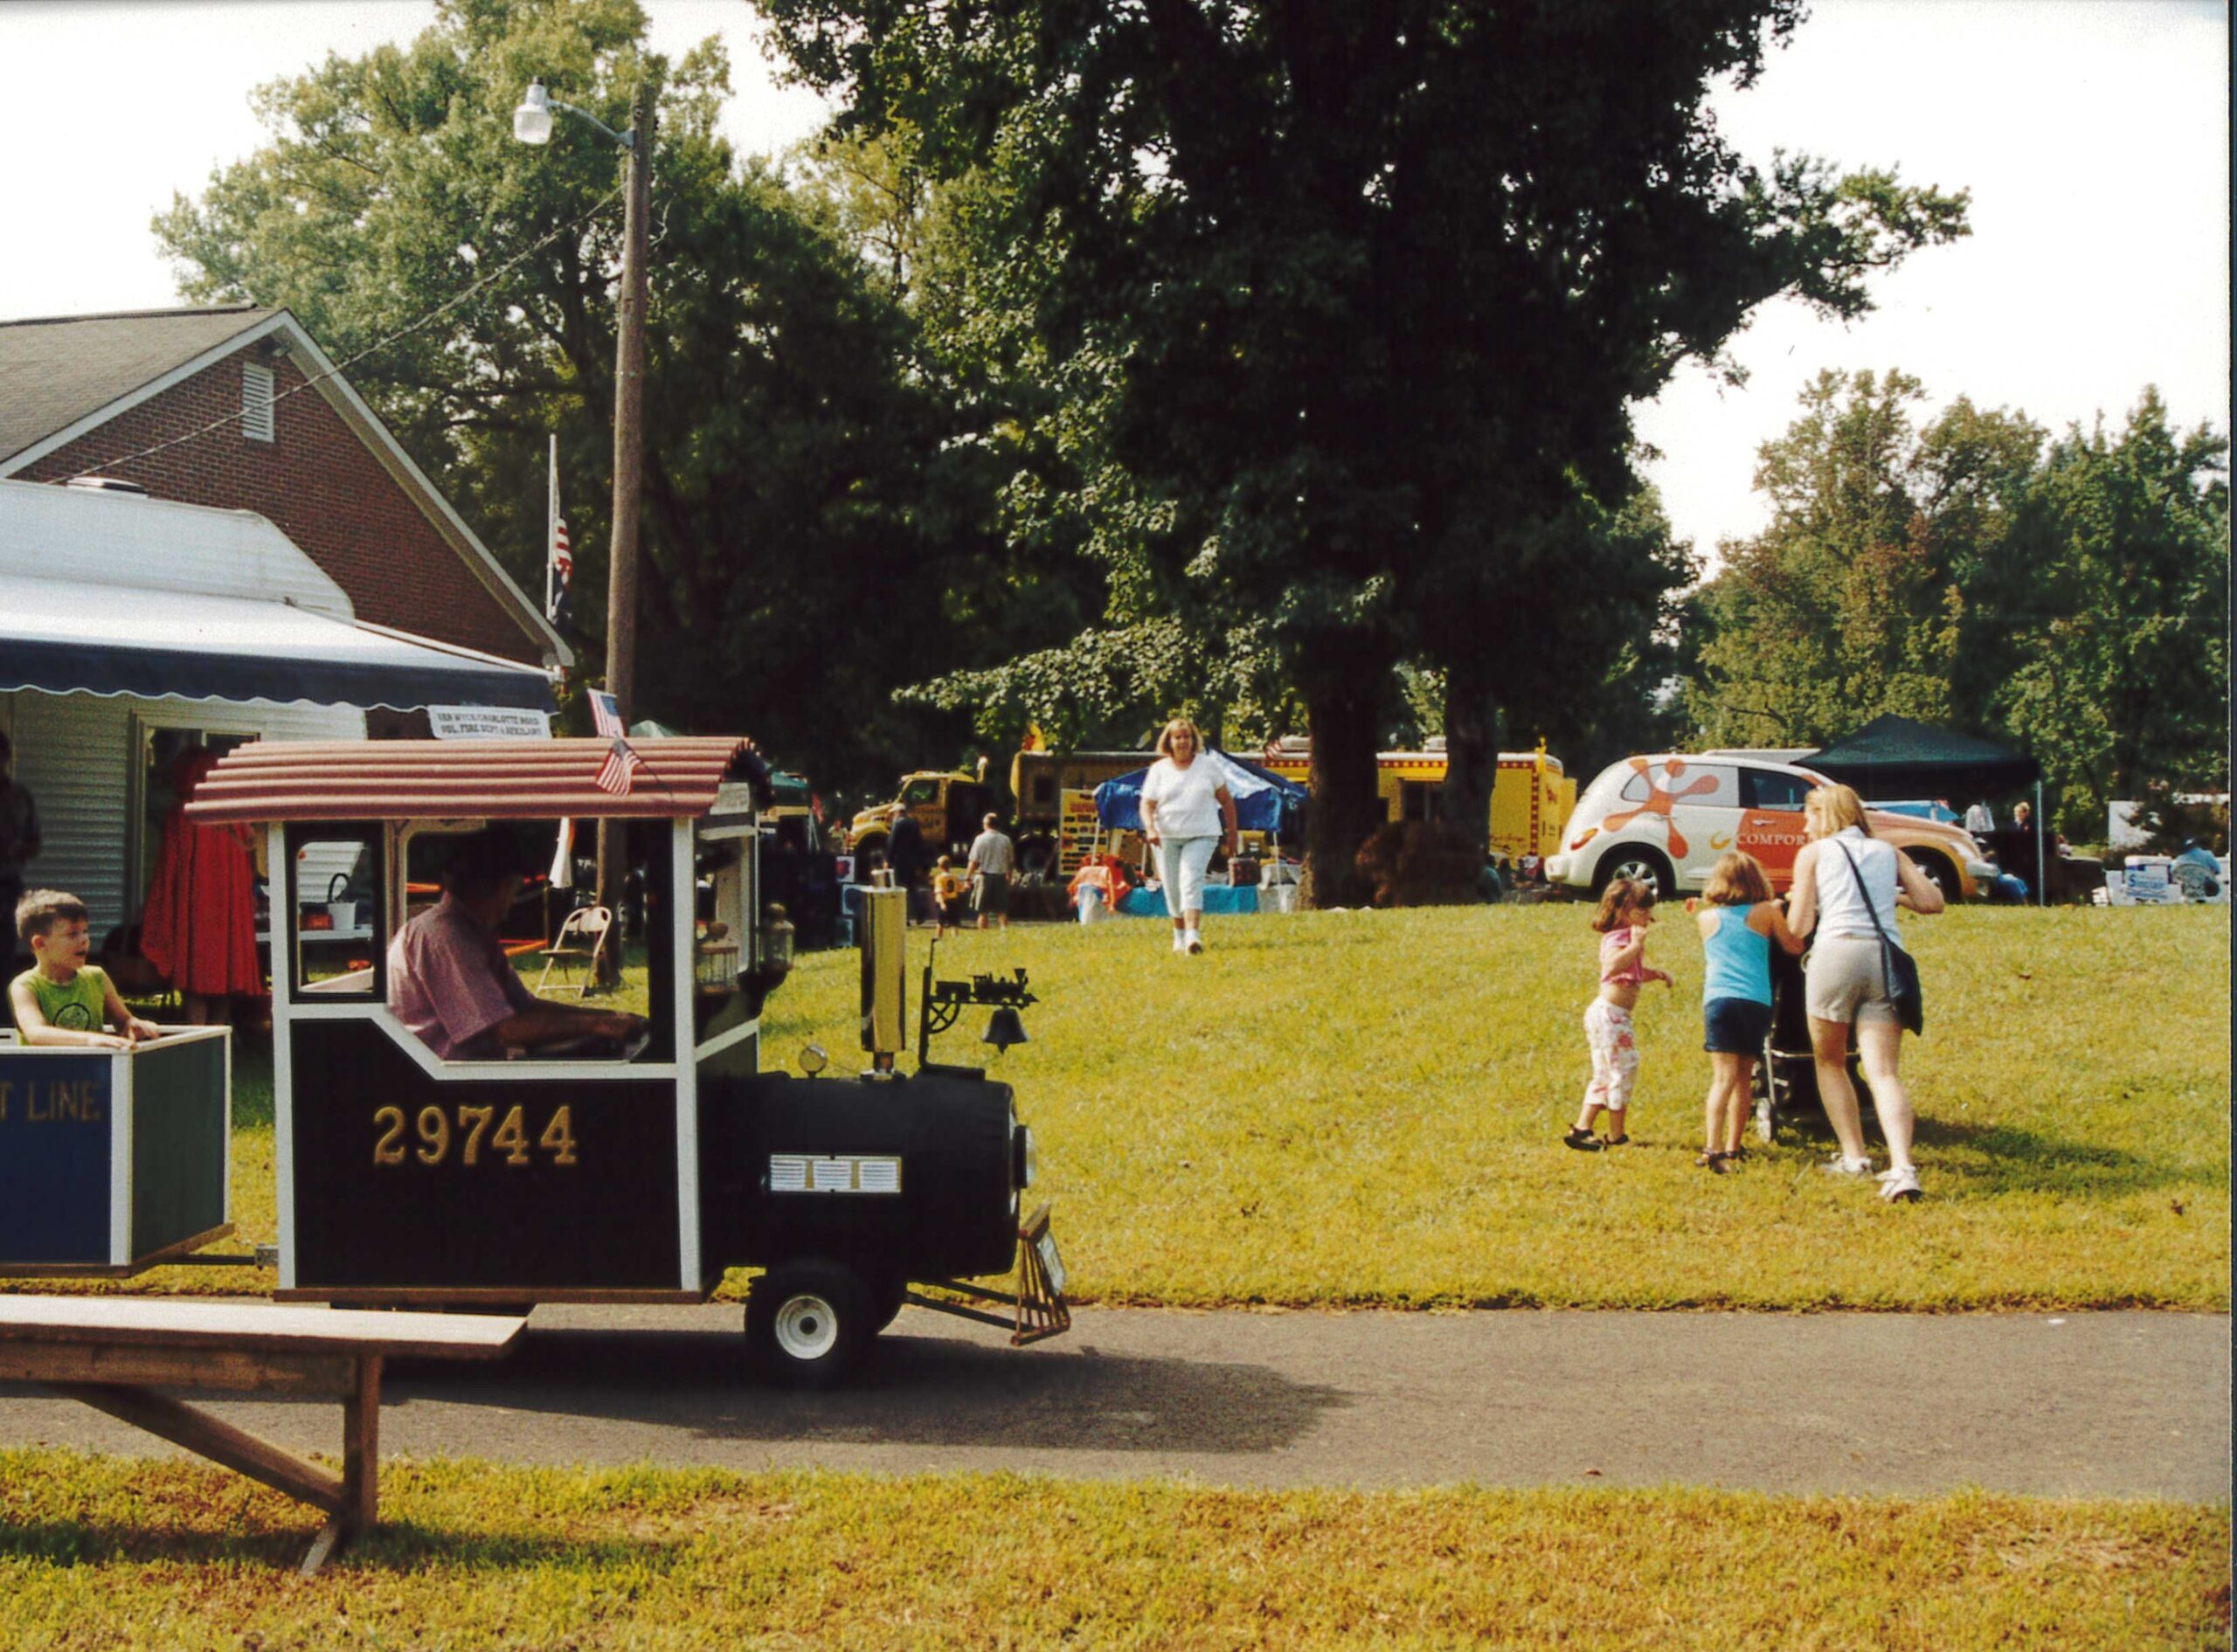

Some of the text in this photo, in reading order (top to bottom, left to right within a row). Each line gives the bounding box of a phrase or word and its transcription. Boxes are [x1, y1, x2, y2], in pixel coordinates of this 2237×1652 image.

[1736, 833, 1812, 847] COMPOR
[27, 1080, 101, 1121] LINE
[373, 1104, 577, 1165] 29744
